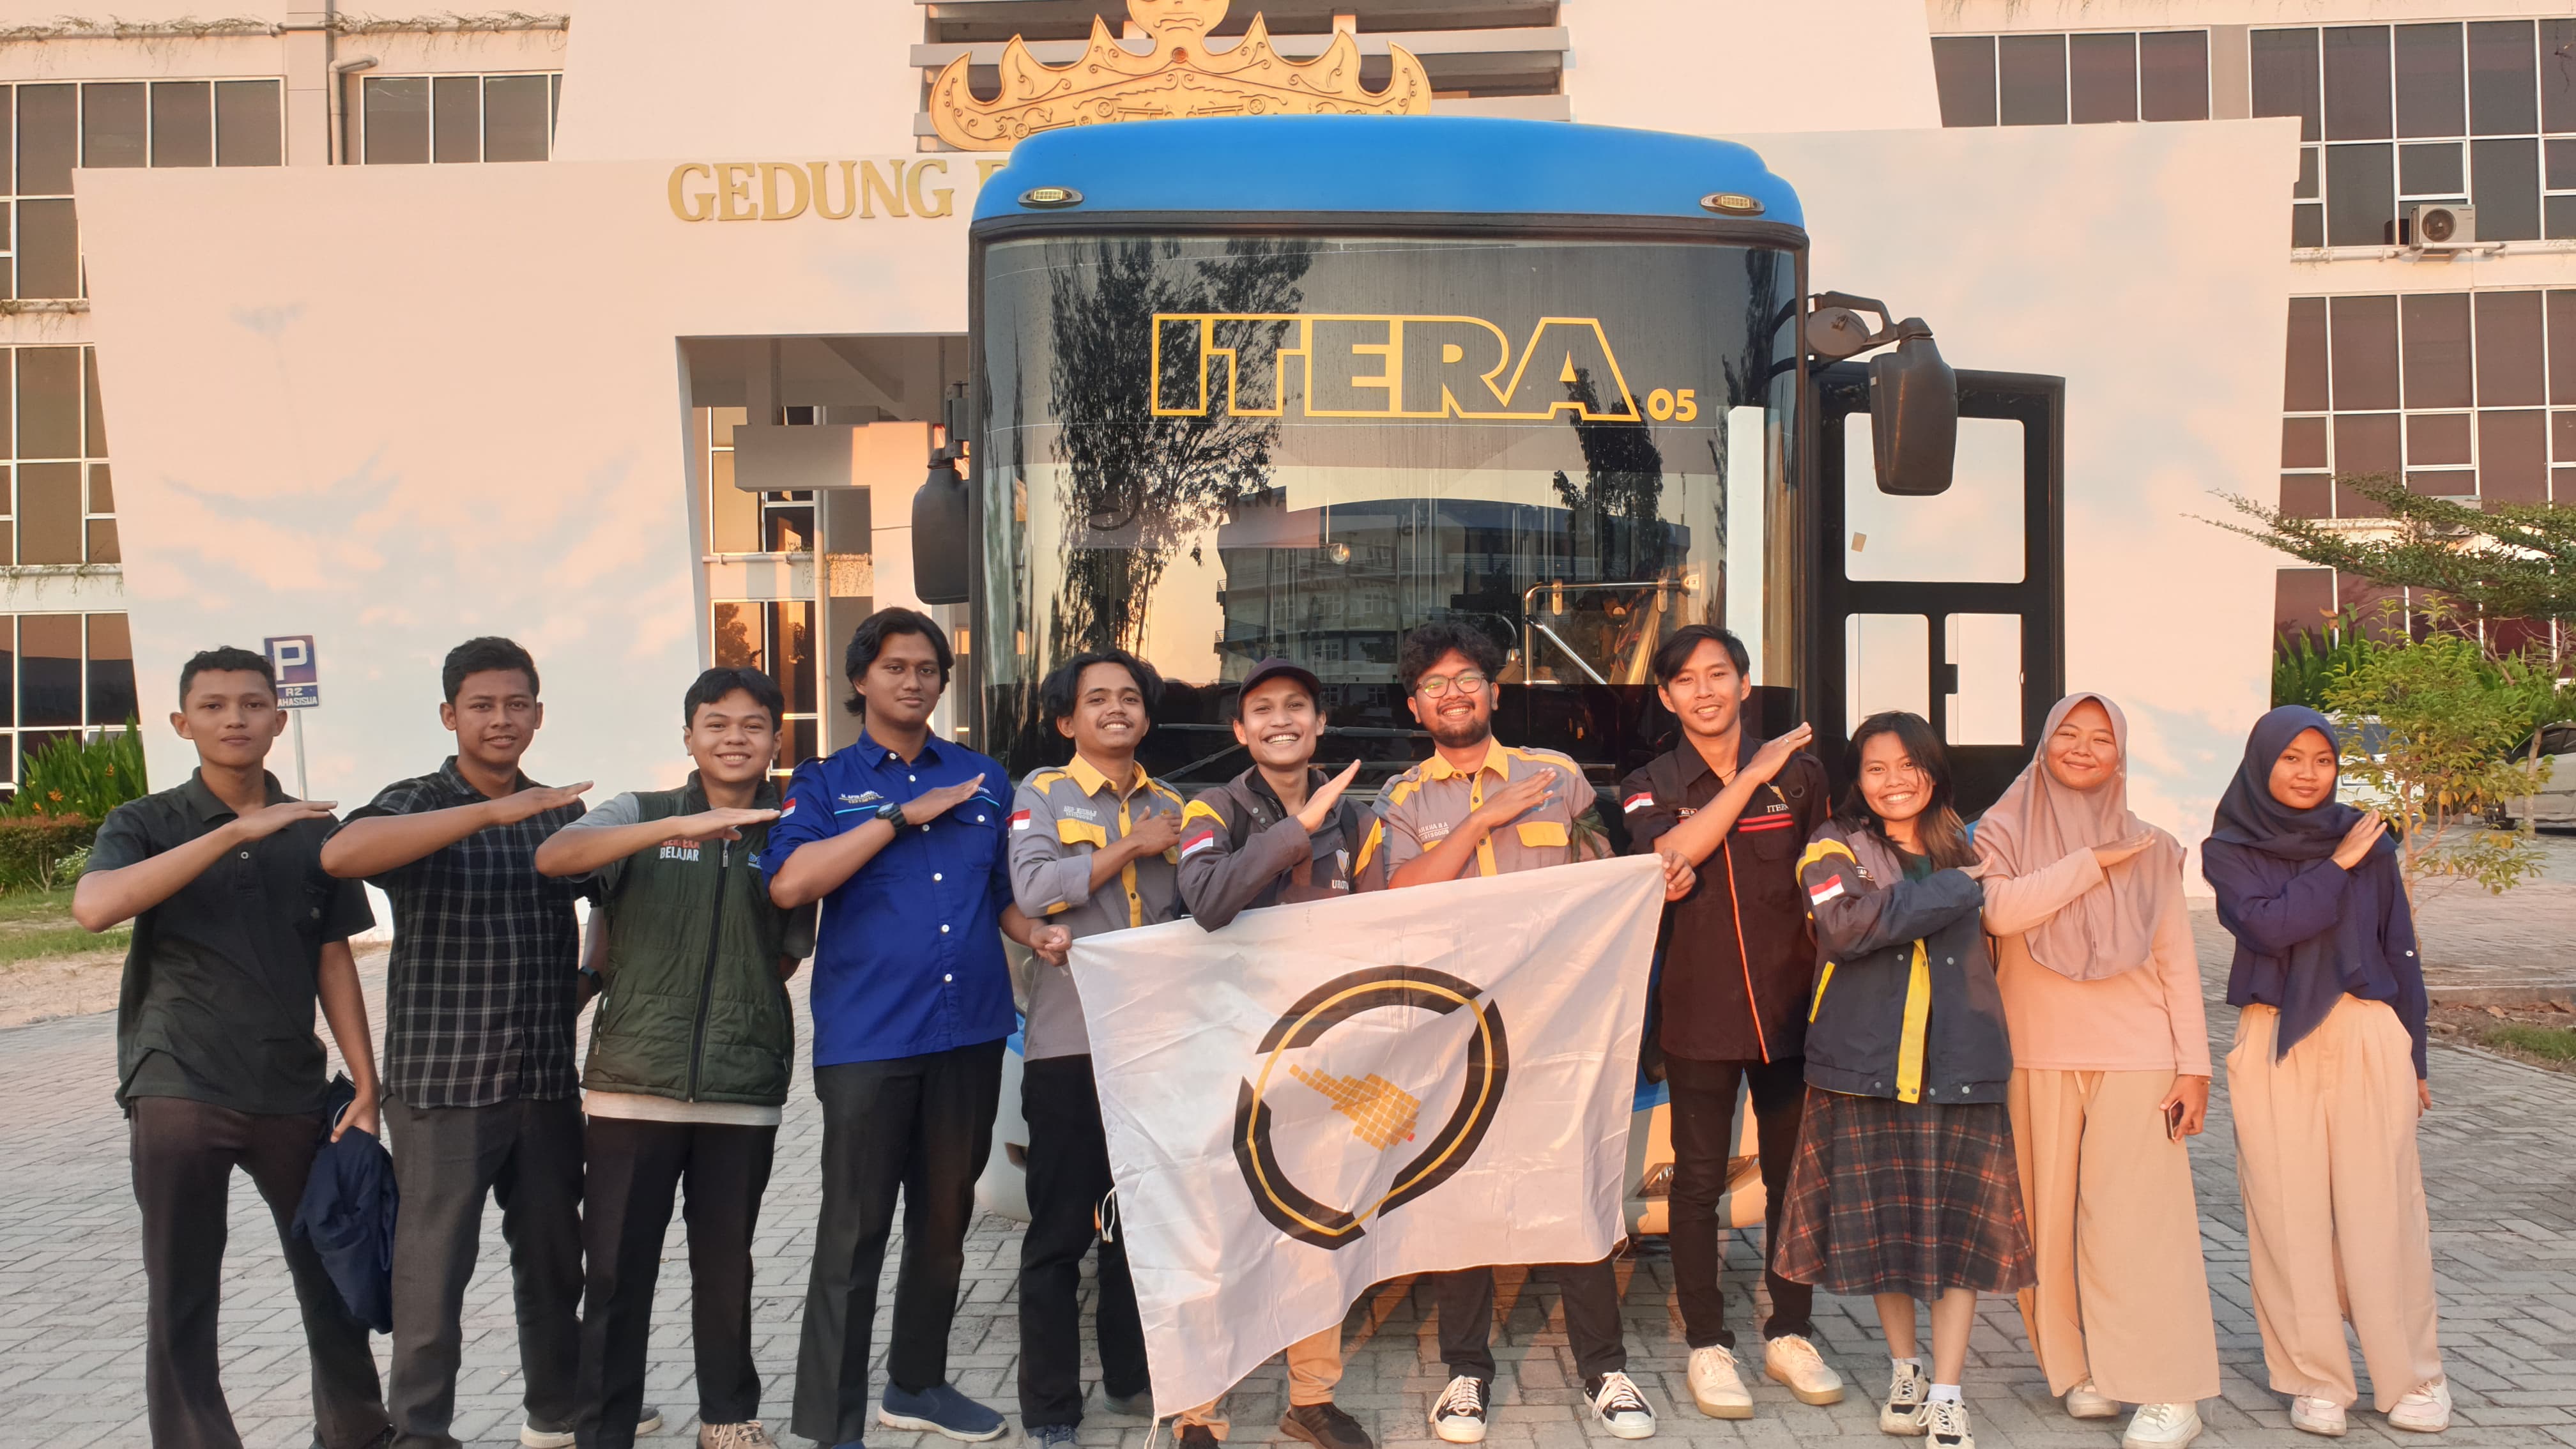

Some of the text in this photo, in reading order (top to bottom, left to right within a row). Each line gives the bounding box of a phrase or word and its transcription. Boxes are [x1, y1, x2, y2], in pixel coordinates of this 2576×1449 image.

[668, 158, 953, 221] GEDUNG
[1151, 313, 1698, 422] ITERA 05
[273, 640, 307, 680] P
[277, 696, 318, 707] AHASISWA
[286, 687, 303, 696] R2
[659, 846, 700, 862] BELAJAR
